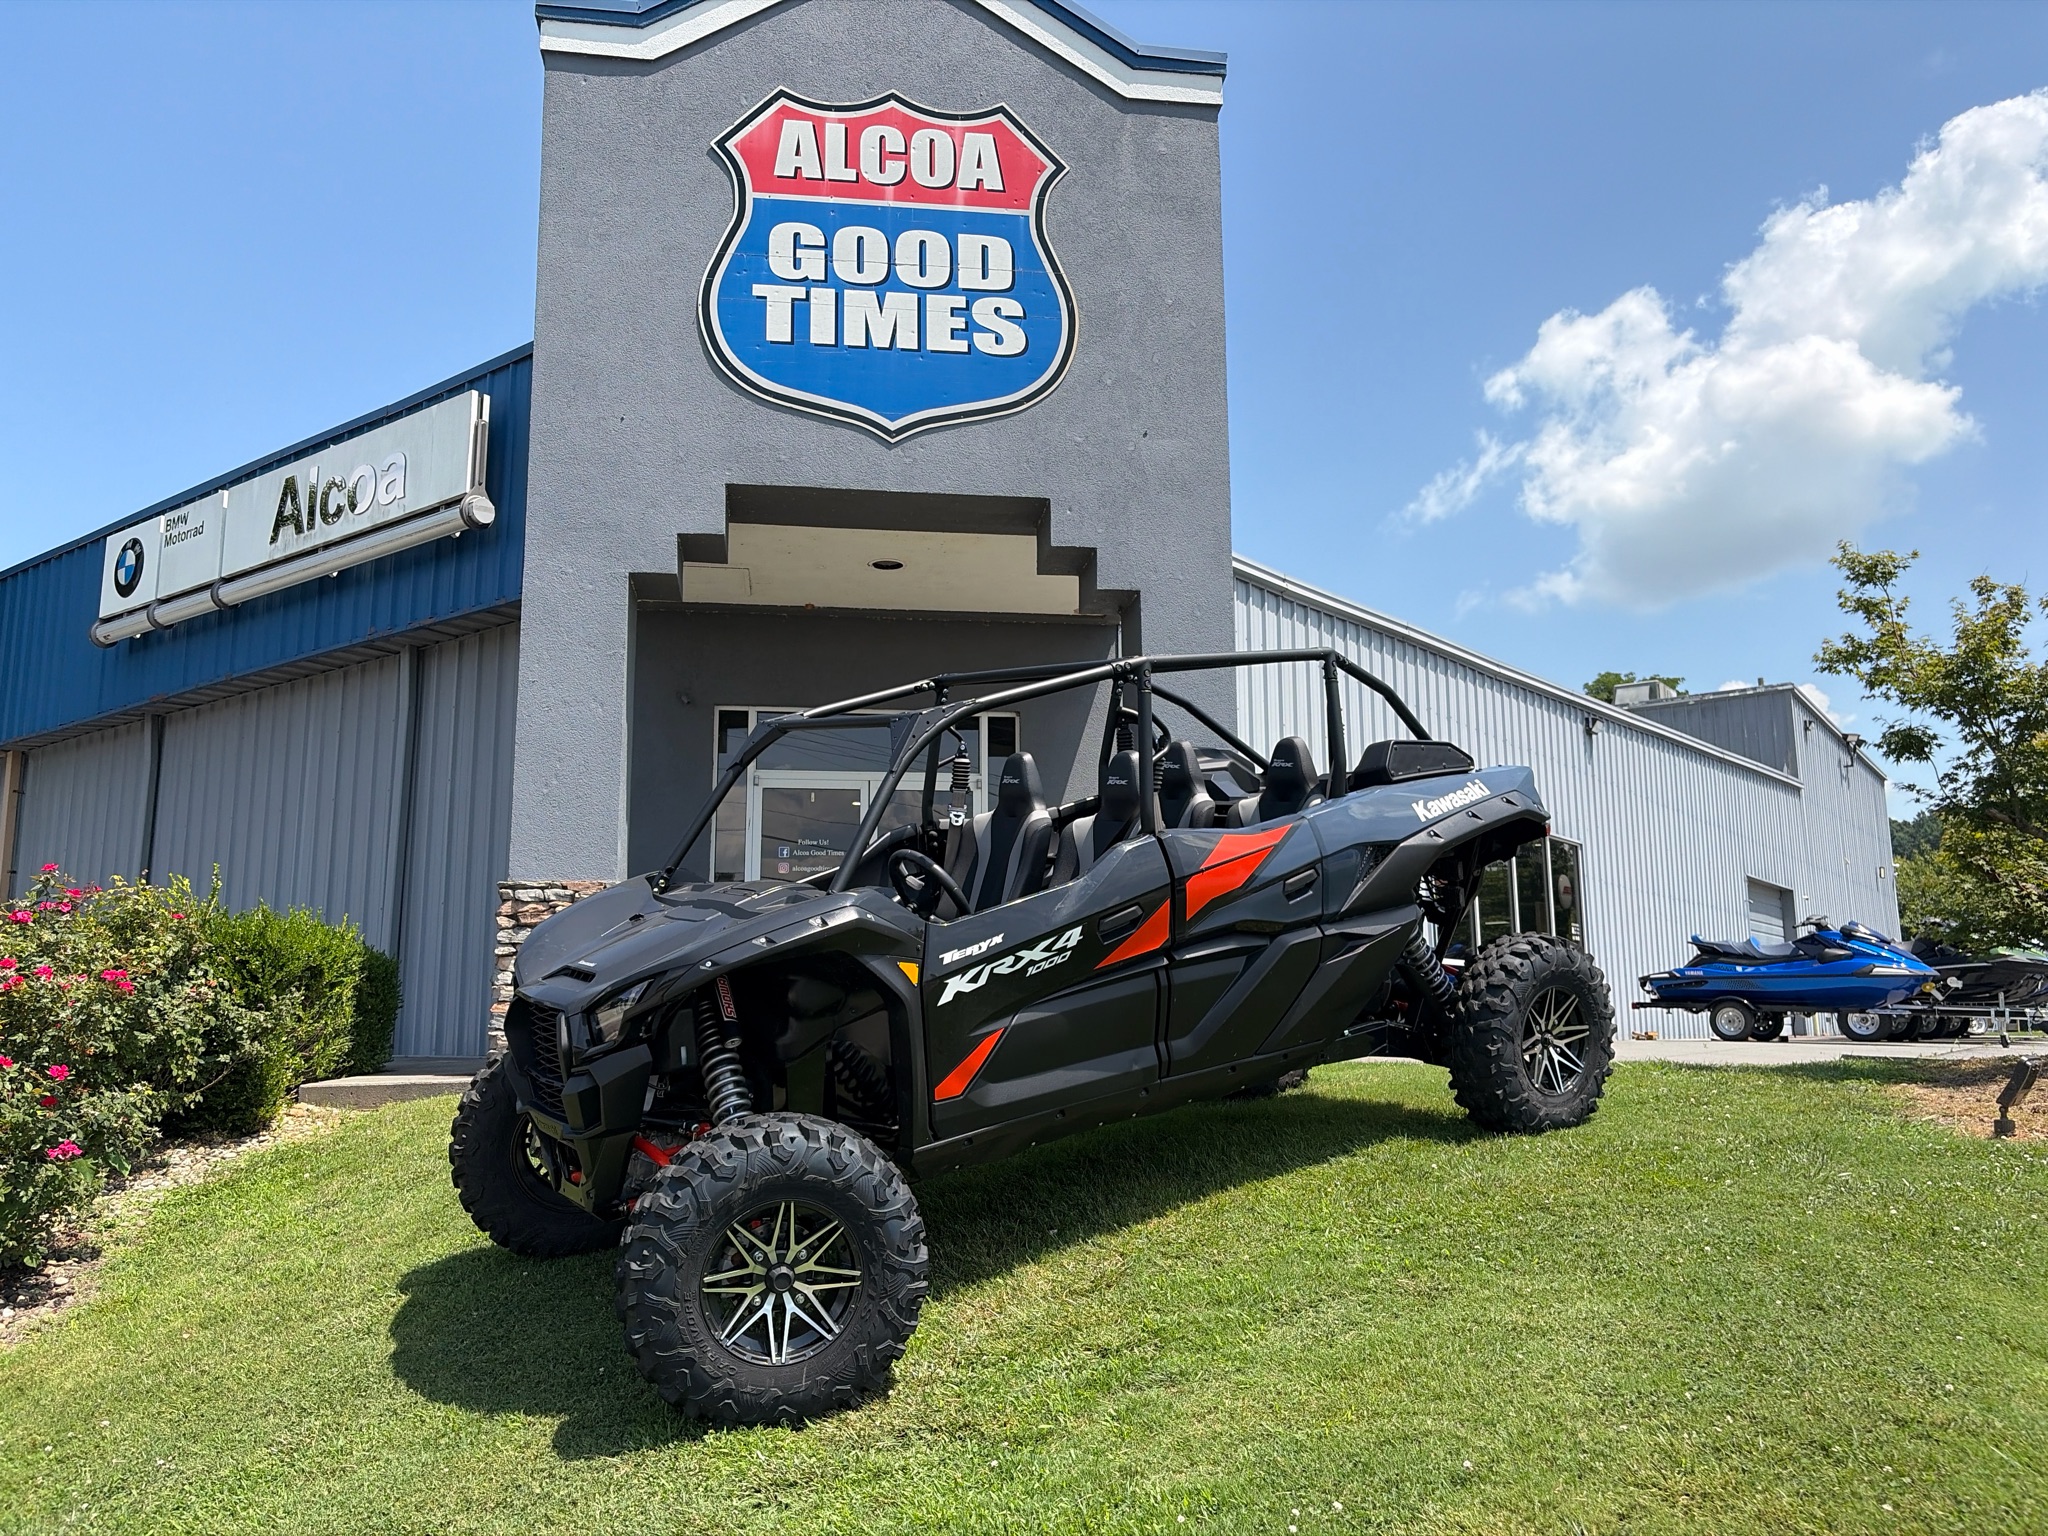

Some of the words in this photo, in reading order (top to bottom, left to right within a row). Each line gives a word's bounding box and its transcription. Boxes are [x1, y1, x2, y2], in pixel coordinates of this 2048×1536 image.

[773, 119, 1005, 192] ALCOA
[768, 222, 1015, 291] GOOD
[752, 284, 1028, 356] TIMES
[269, 452, 406, 545] Alcoa
[163, 520, 205, 549] Motorrad
[165, 511, 190, 533] BMW
[1411, 778, 1491, 823] Kawasaki
[798, 838, 818, 846] Follow
[1026, 950, 1073, 978] 1000
[717, 977, 738, 1019] SHOWA
[684, 1291, 738, 1377] CARNIVORE
